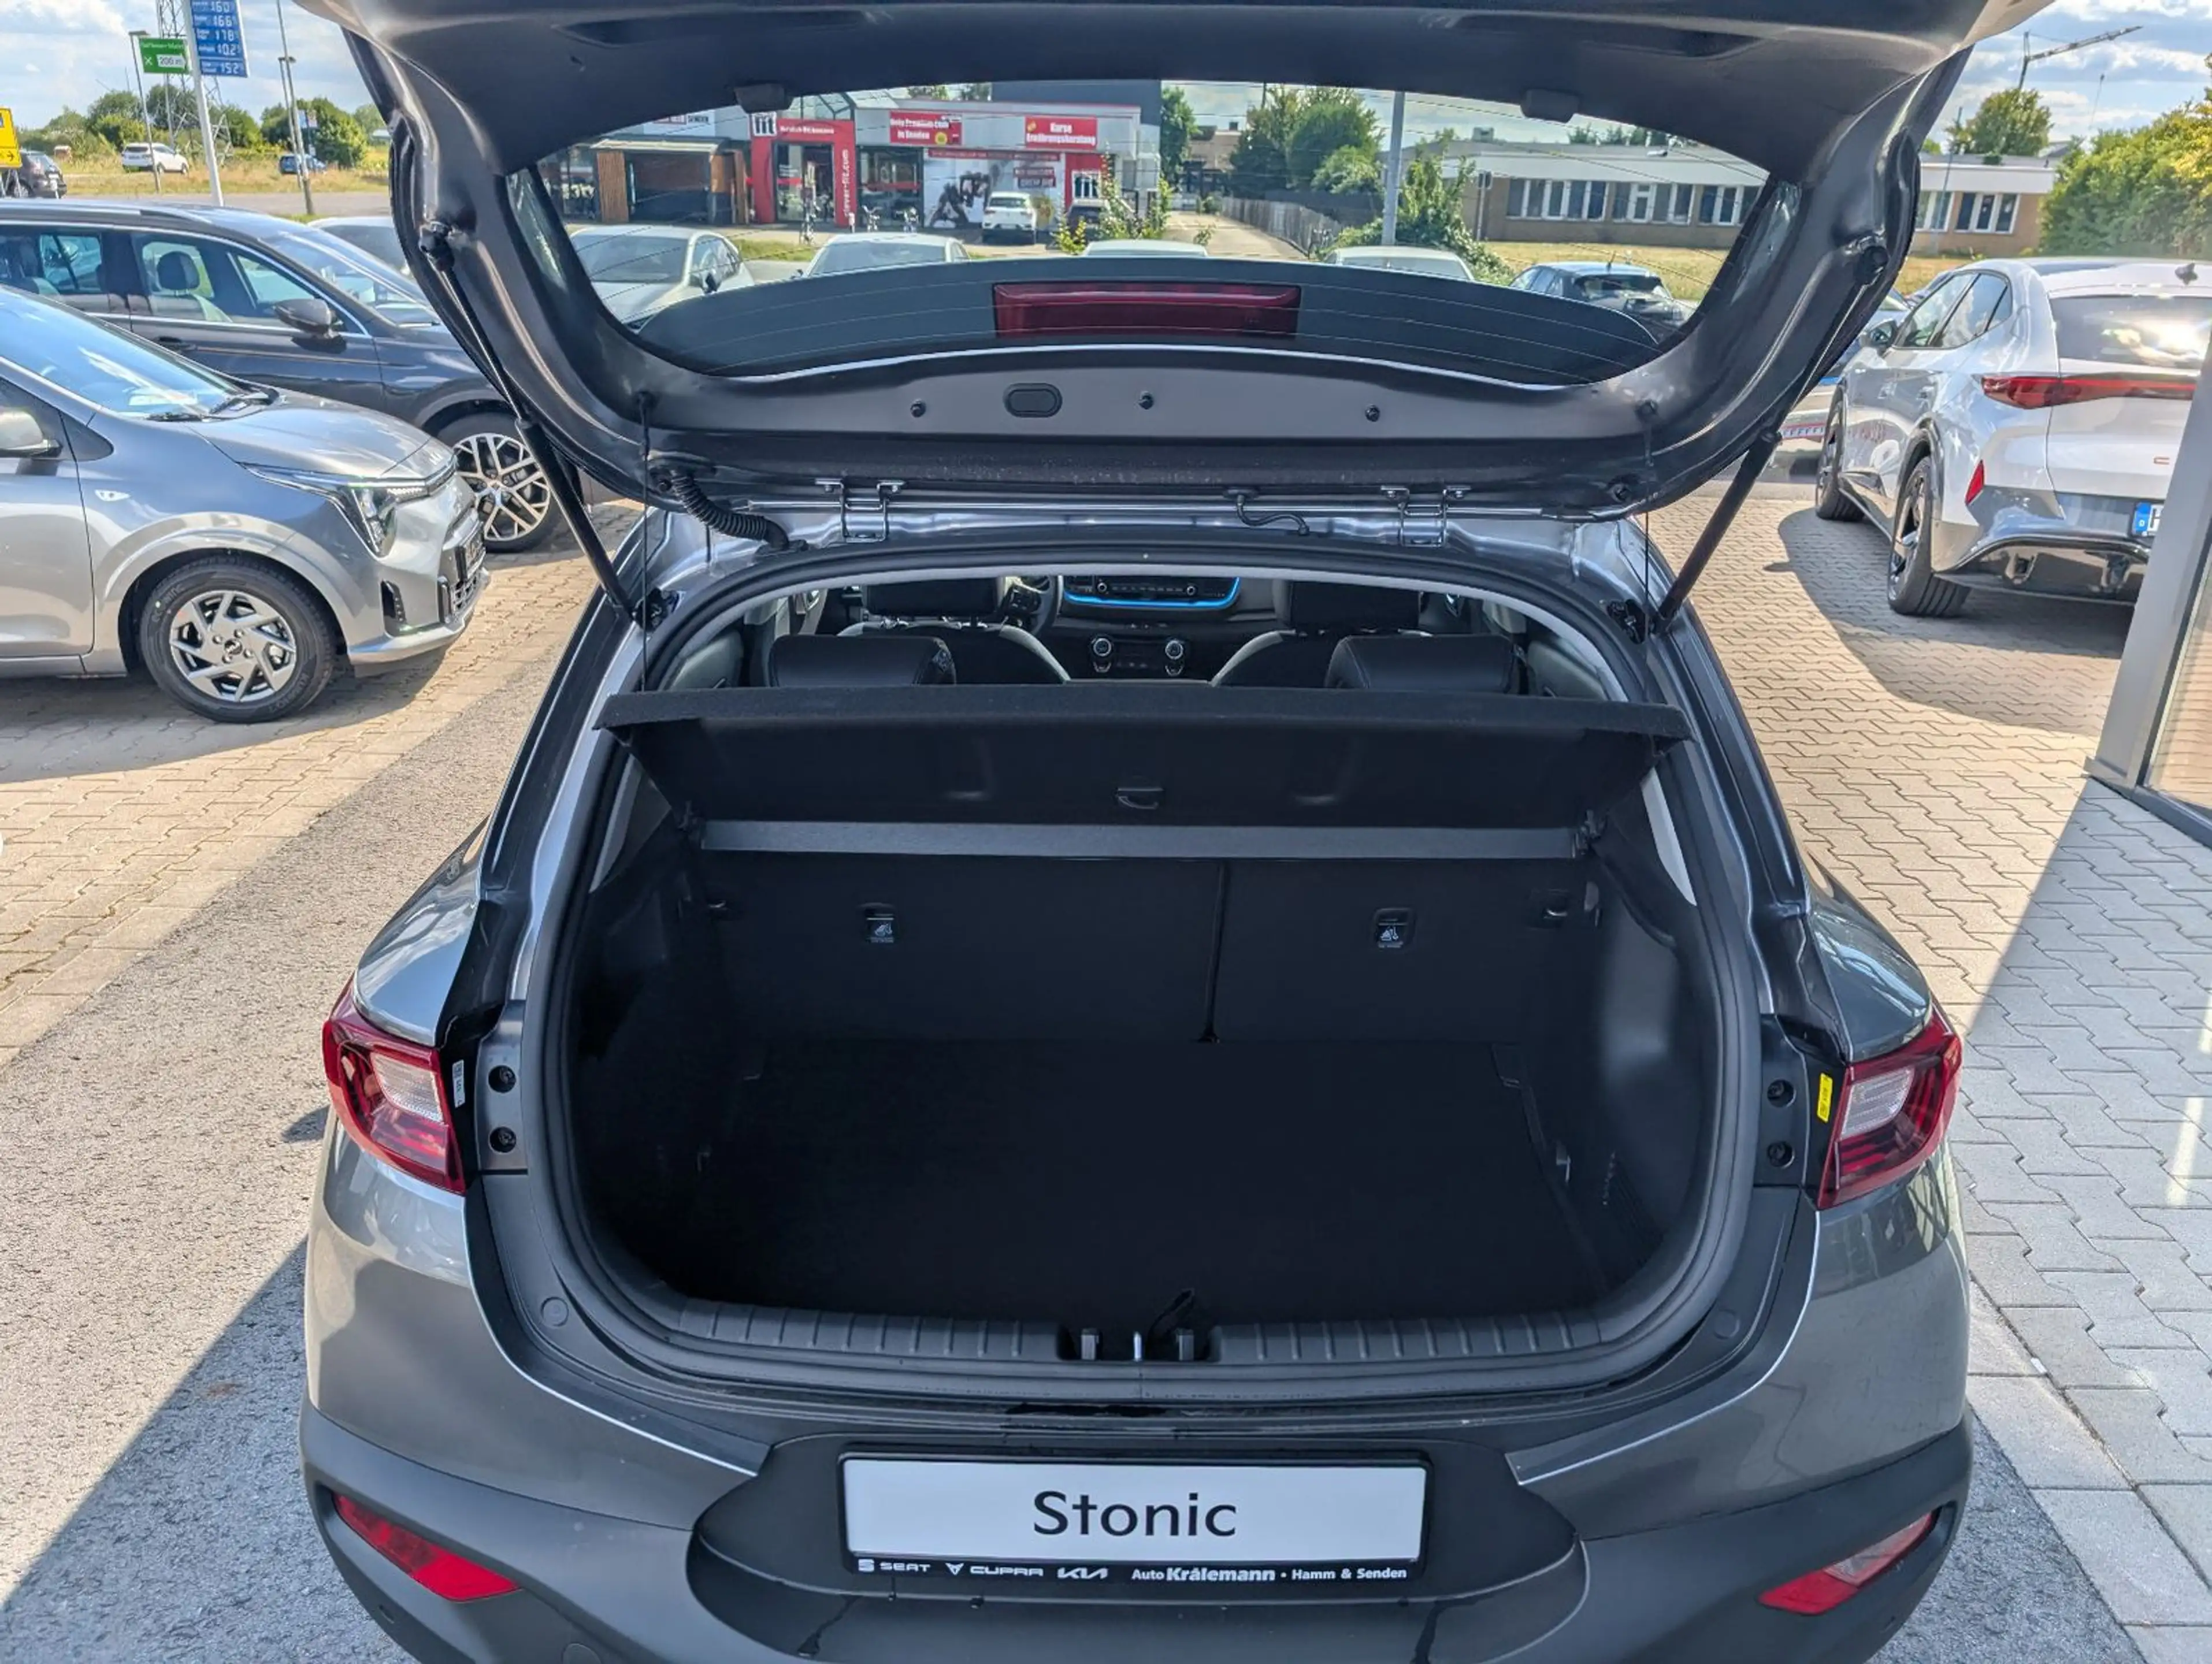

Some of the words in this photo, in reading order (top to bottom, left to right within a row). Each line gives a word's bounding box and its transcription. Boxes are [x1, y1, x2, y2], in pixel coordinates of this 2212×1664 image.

[1033, 1490, 1237, 1537] Stonic
[880, 1562, 931, 1573] SEAT
[970, 1565, 1044, 1577] CUPRA
[1131, 1568, 1164, 1580] Auto
[1291, 1568, 1336, 1580] Hamm
[1340, 1568, 1352, 1580] &
[1356, 1567, 1407, 1580] Senden
